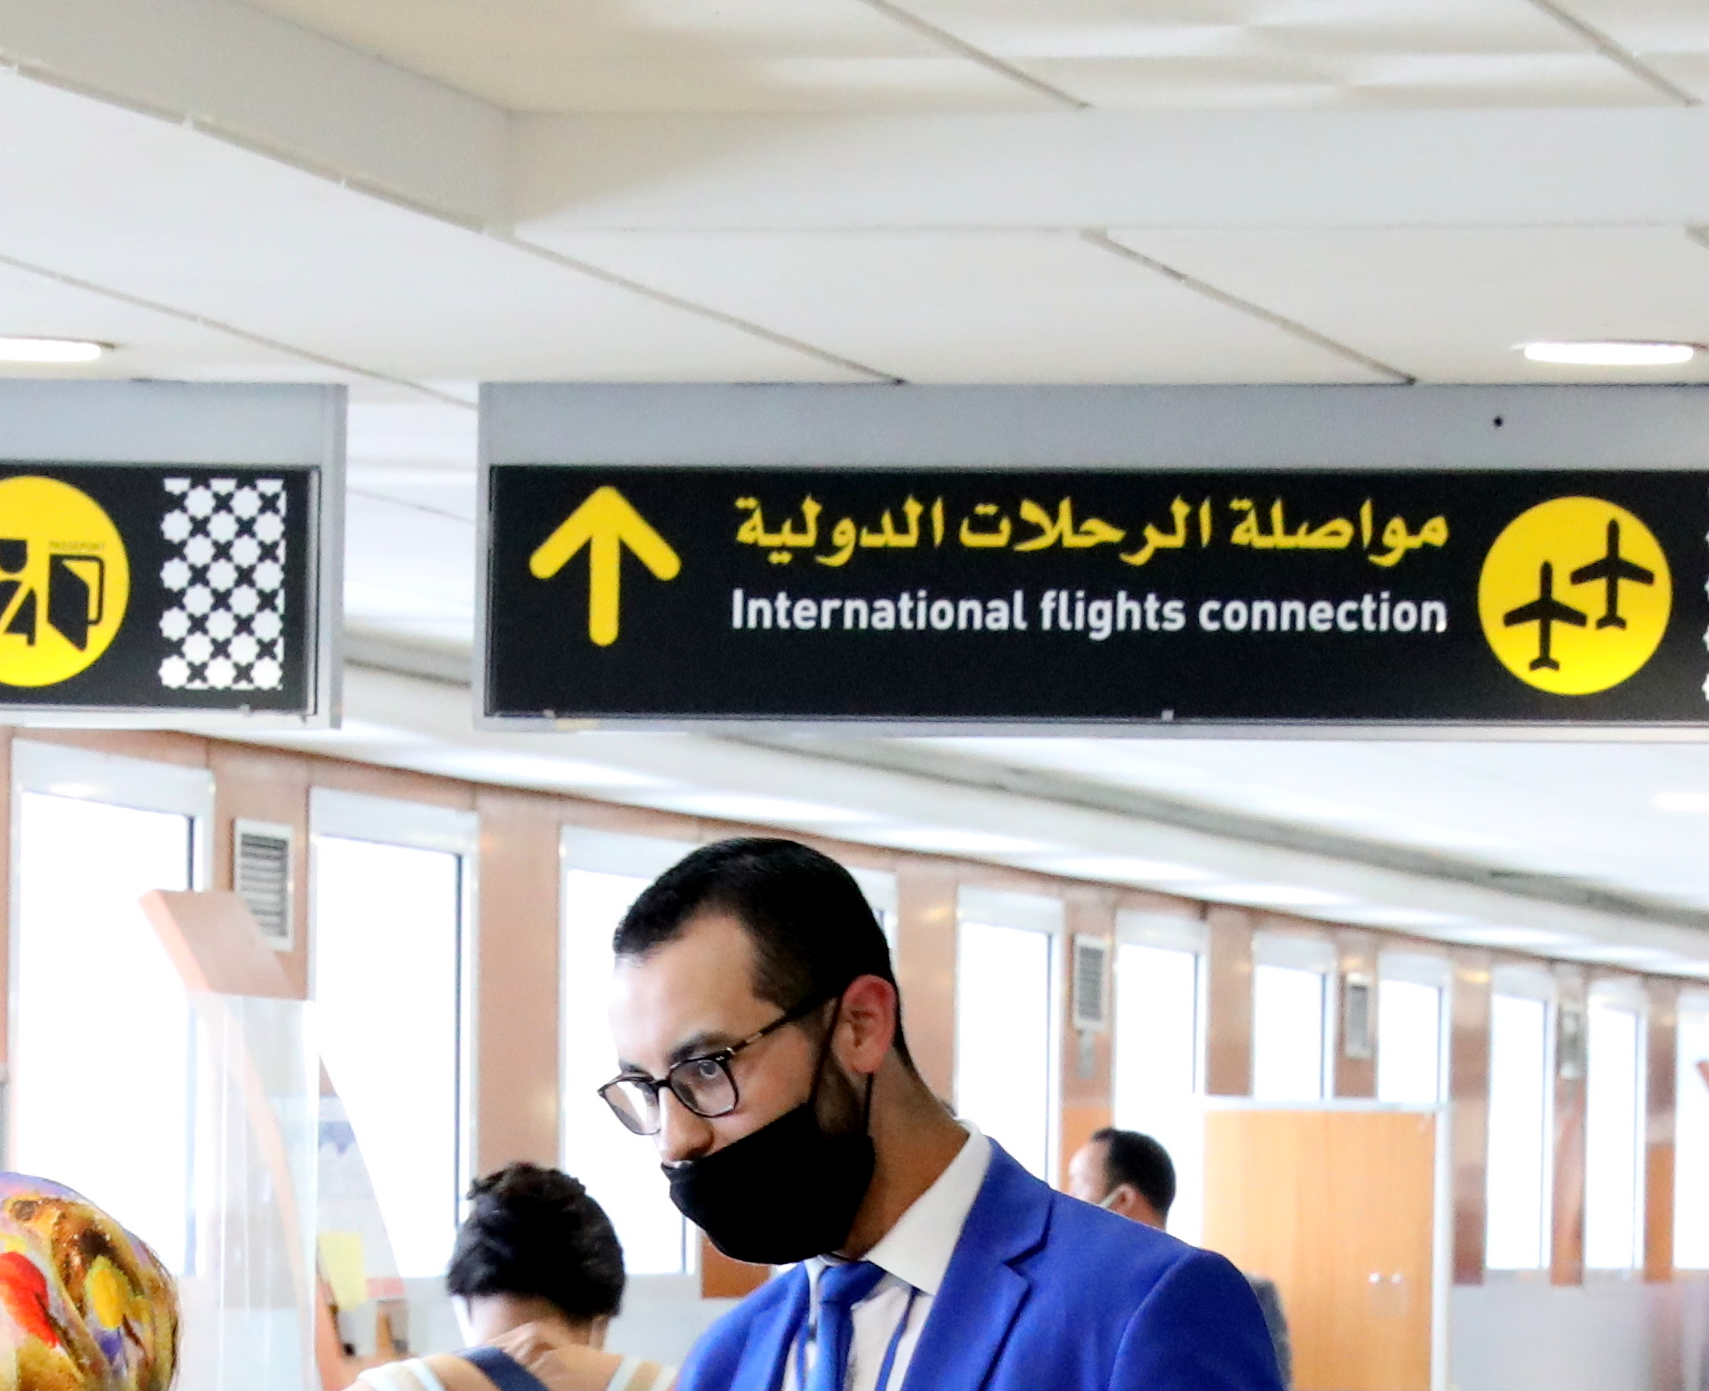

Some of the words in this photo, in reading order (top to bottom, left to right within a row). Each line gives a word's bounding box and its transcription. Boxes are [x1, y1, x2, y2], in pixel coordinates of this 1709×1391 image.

[735, 496, 945, 567] الدولية
[959, 496, 1212, 566] الرحلات
[1229, 498, 1449, 567] مواصلة
[732, 588, 1028, 631] International
[1040, 589, 1186, 641] flights
[1198, 590, 1447, 633] connection
